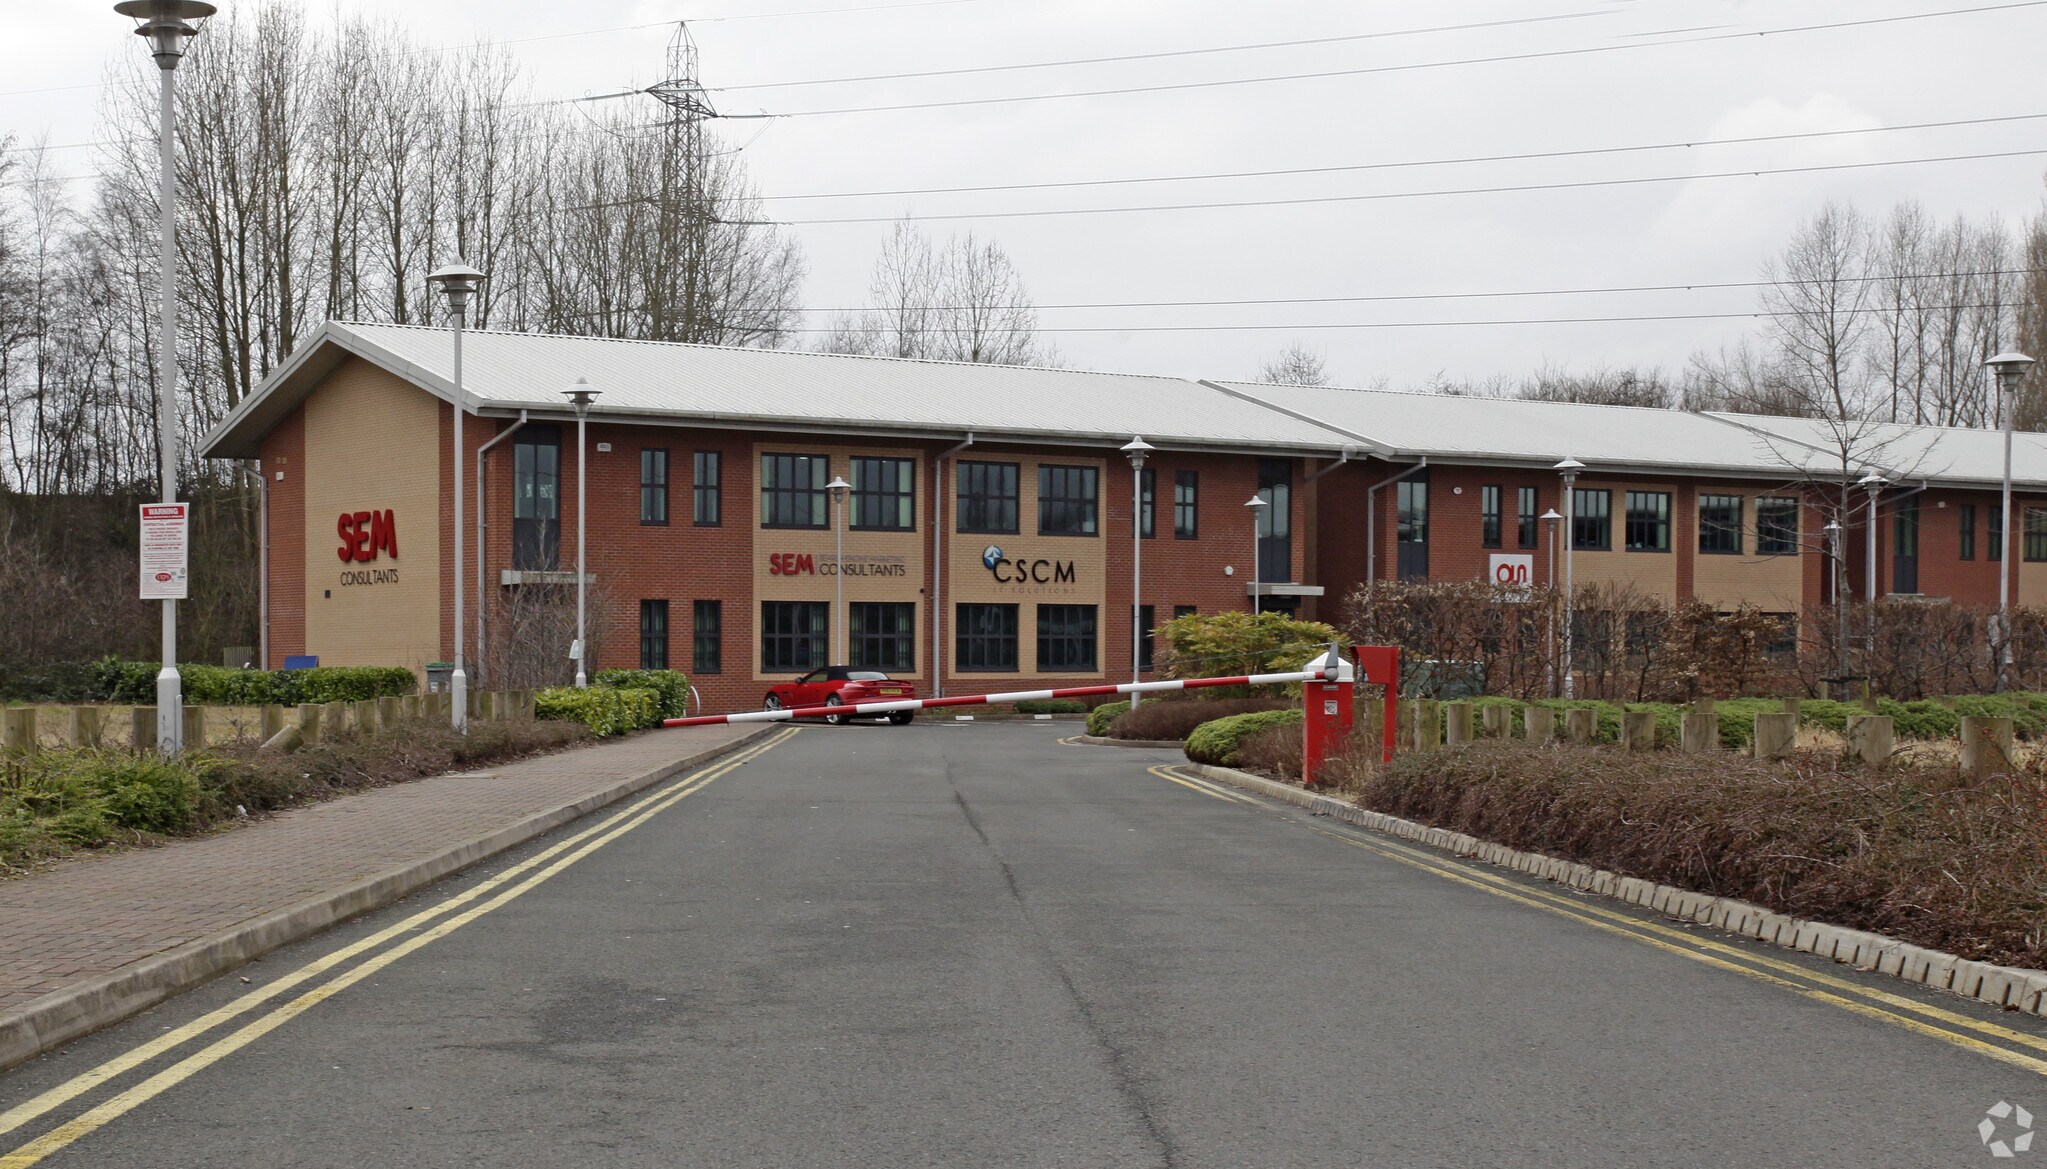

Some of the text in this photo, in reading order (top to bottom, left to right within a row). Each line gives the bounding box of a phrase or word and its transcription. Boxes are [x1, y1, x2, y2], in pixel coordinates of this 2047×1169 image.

[337, 509, 398, 562] SEM
[769, 552, 815, 575] SEM
[819, 563, 906, 576] CONSULTANTS
[993, 558, 1076, 583] CSCM
[340, 568, 399, 586] CONSULTANTS
